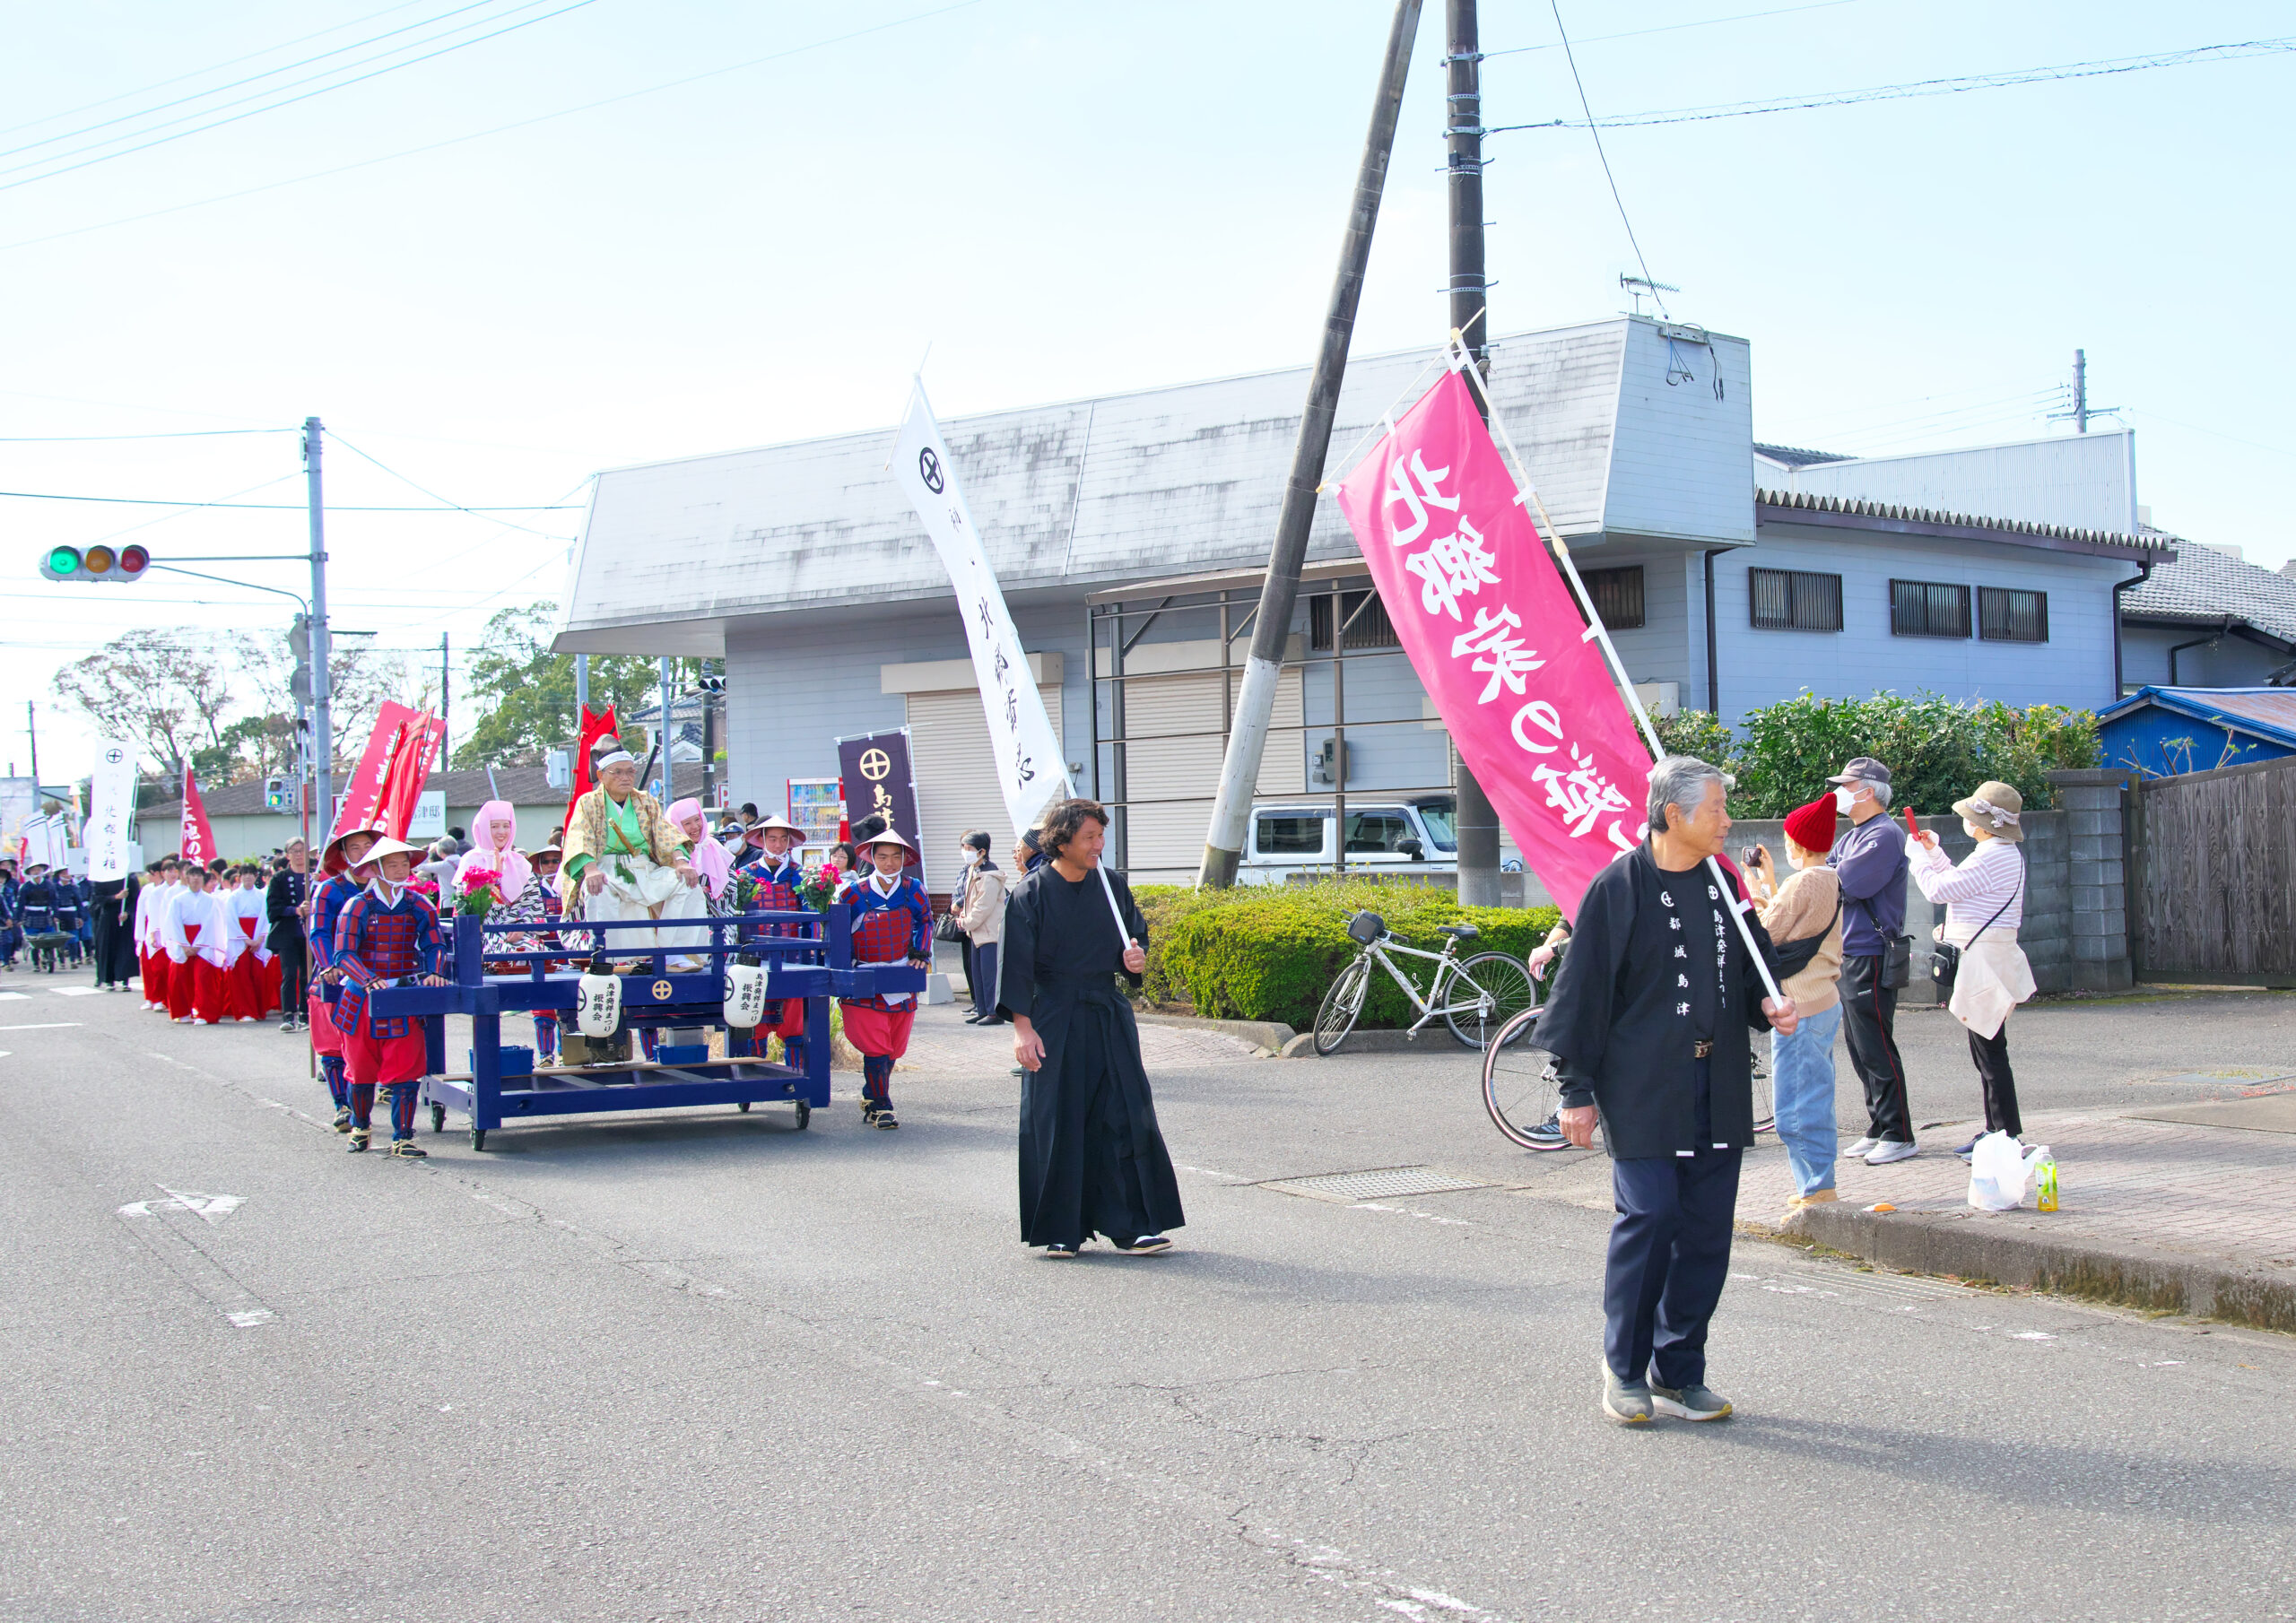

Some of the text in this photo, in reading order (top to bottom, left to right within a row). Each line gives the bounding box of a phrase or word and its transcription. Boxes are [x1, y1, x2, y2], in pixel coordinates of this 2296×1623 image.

[413, 804, 440, 820] 津邸
[1669, 916, 1692, 1017] 都城島津
[592, 993, 604, 1021] 振興会
[604, 982, 616, 1032] 島津発祥まつり
[740, 983, 753, 1011] 振興会
[750, 972, 764, 1022] 島津発祥まつり
